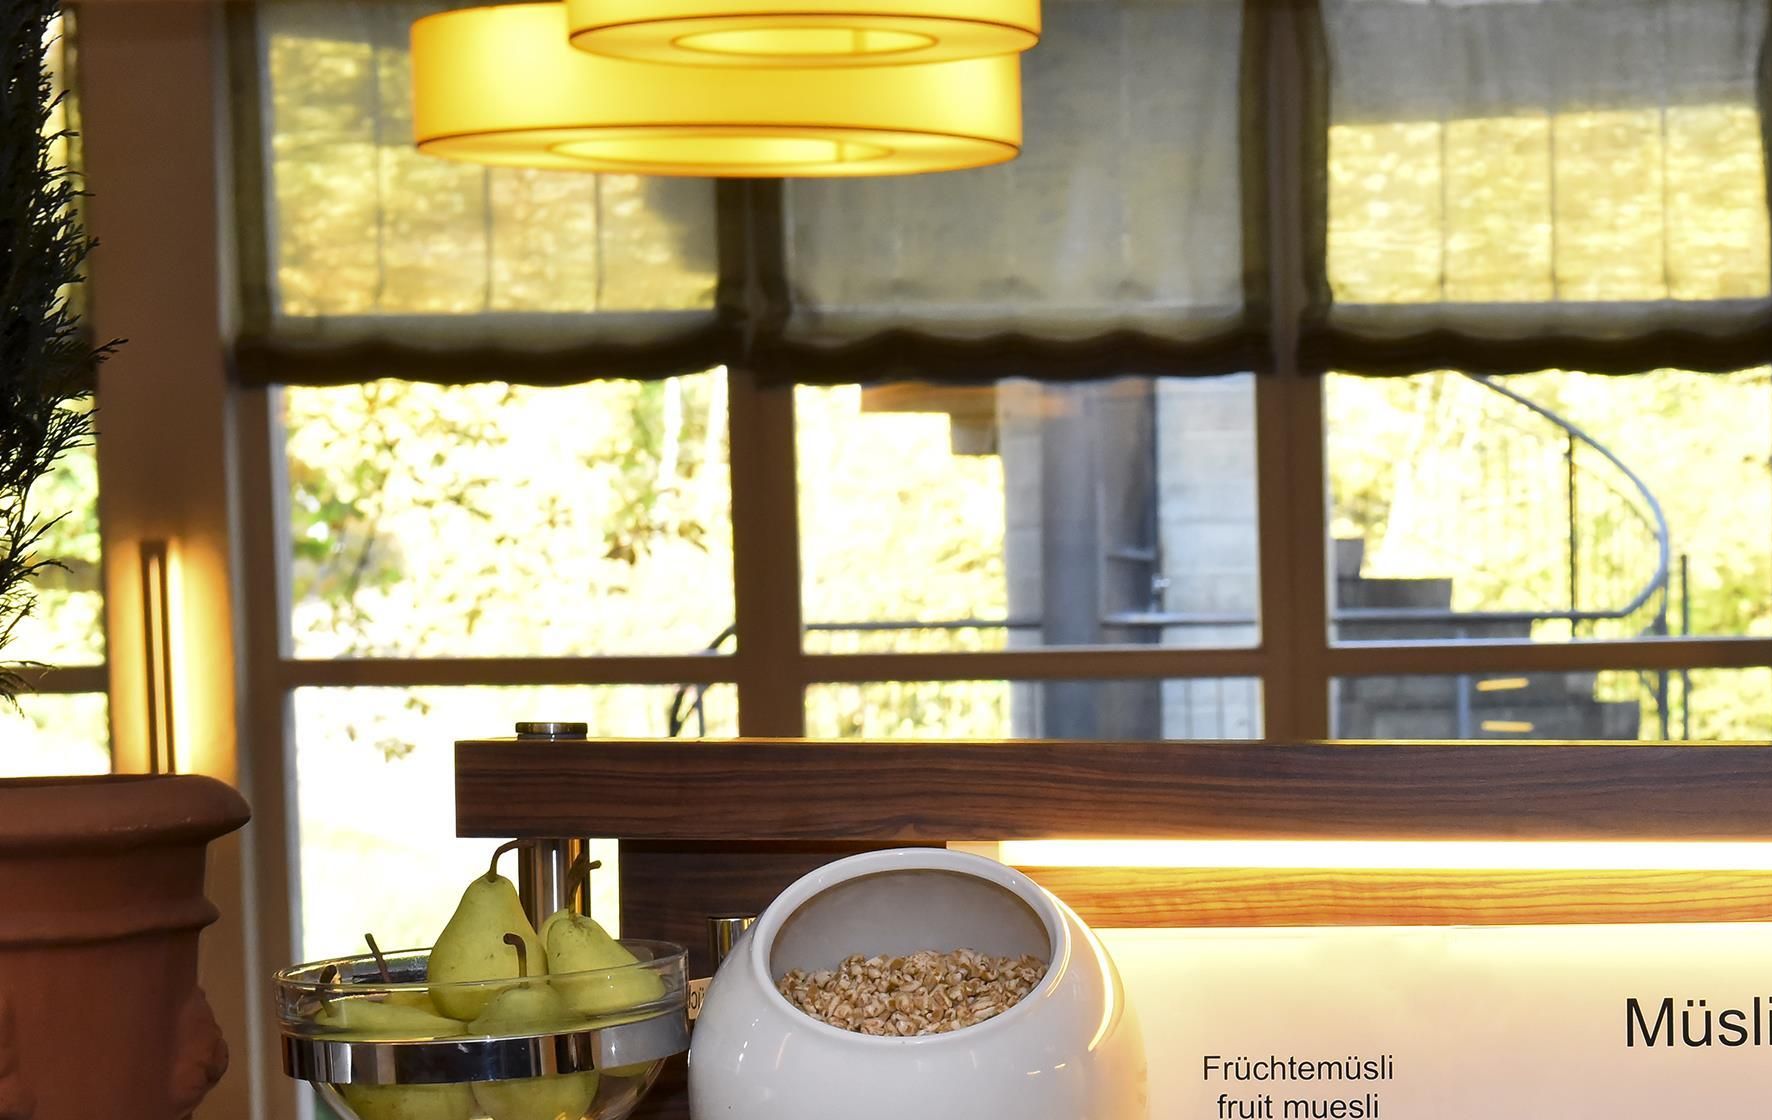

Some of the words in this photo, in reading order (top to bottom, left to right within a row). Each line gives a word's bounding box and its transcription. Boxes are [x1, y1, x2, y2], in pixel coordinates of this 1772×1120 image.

[1203, 1054, 1393, 1081] Früchtemüsli
[1217, 1093, 1273, 1119] fruit
[1283, 1093, 1379, 1119] muesli
